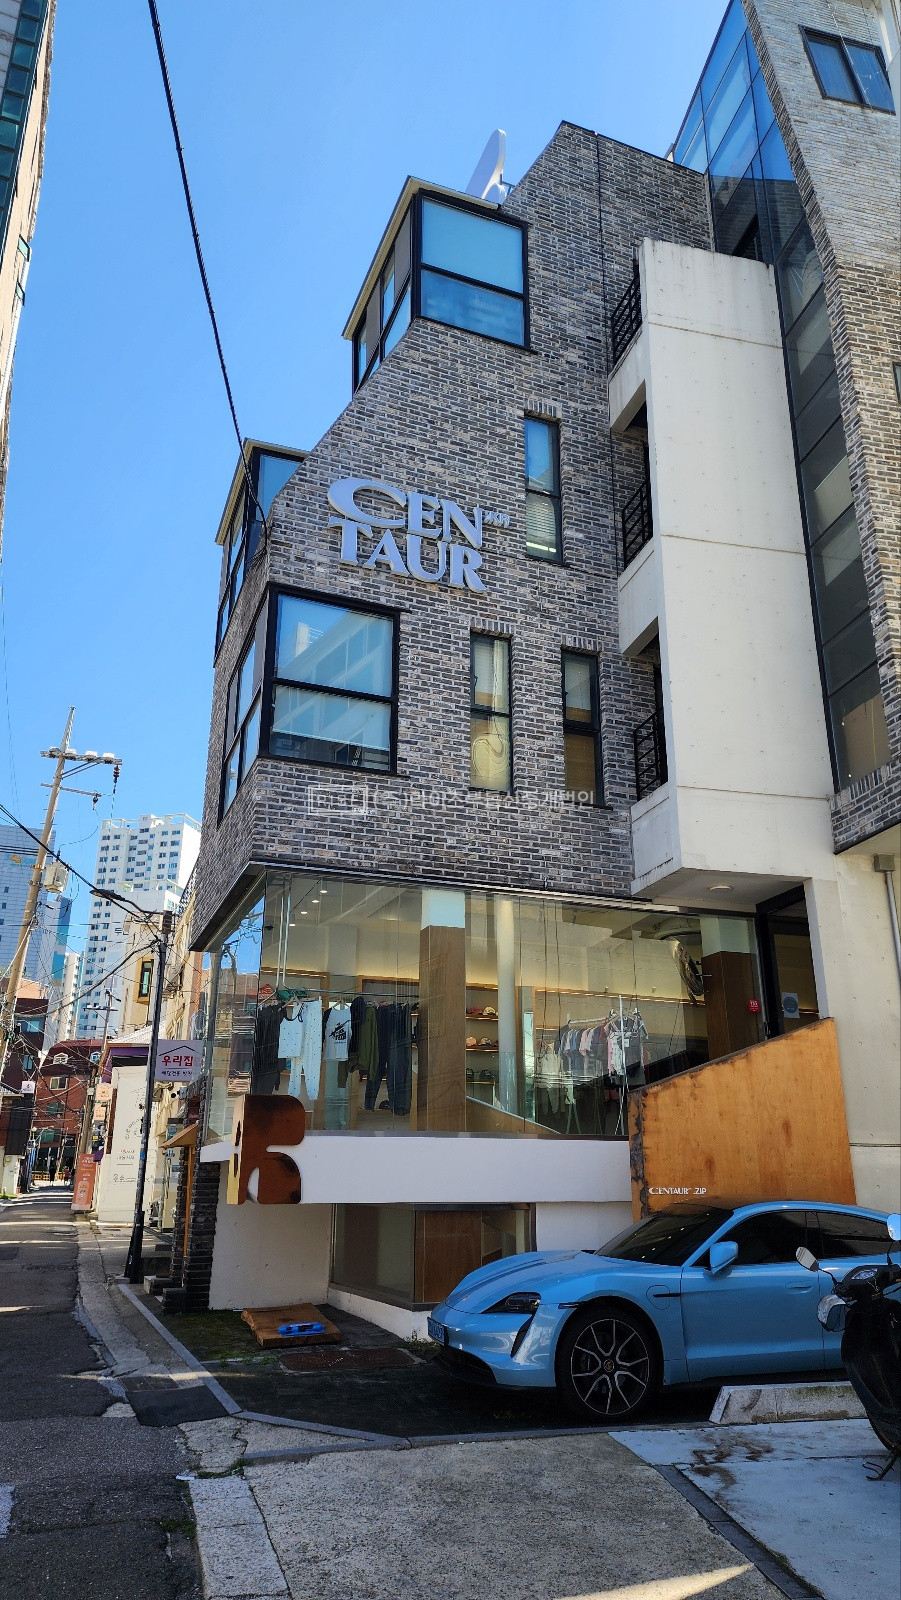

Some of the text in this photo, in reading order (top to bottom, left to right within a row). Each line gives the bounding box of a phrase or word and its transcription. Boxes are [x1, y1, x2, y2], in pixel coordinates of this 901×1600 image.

[327, 476, 483, 549] CEN
[327, 515, 488, 594] TAUR
[161, 1055, 194, 1067] 우리집
